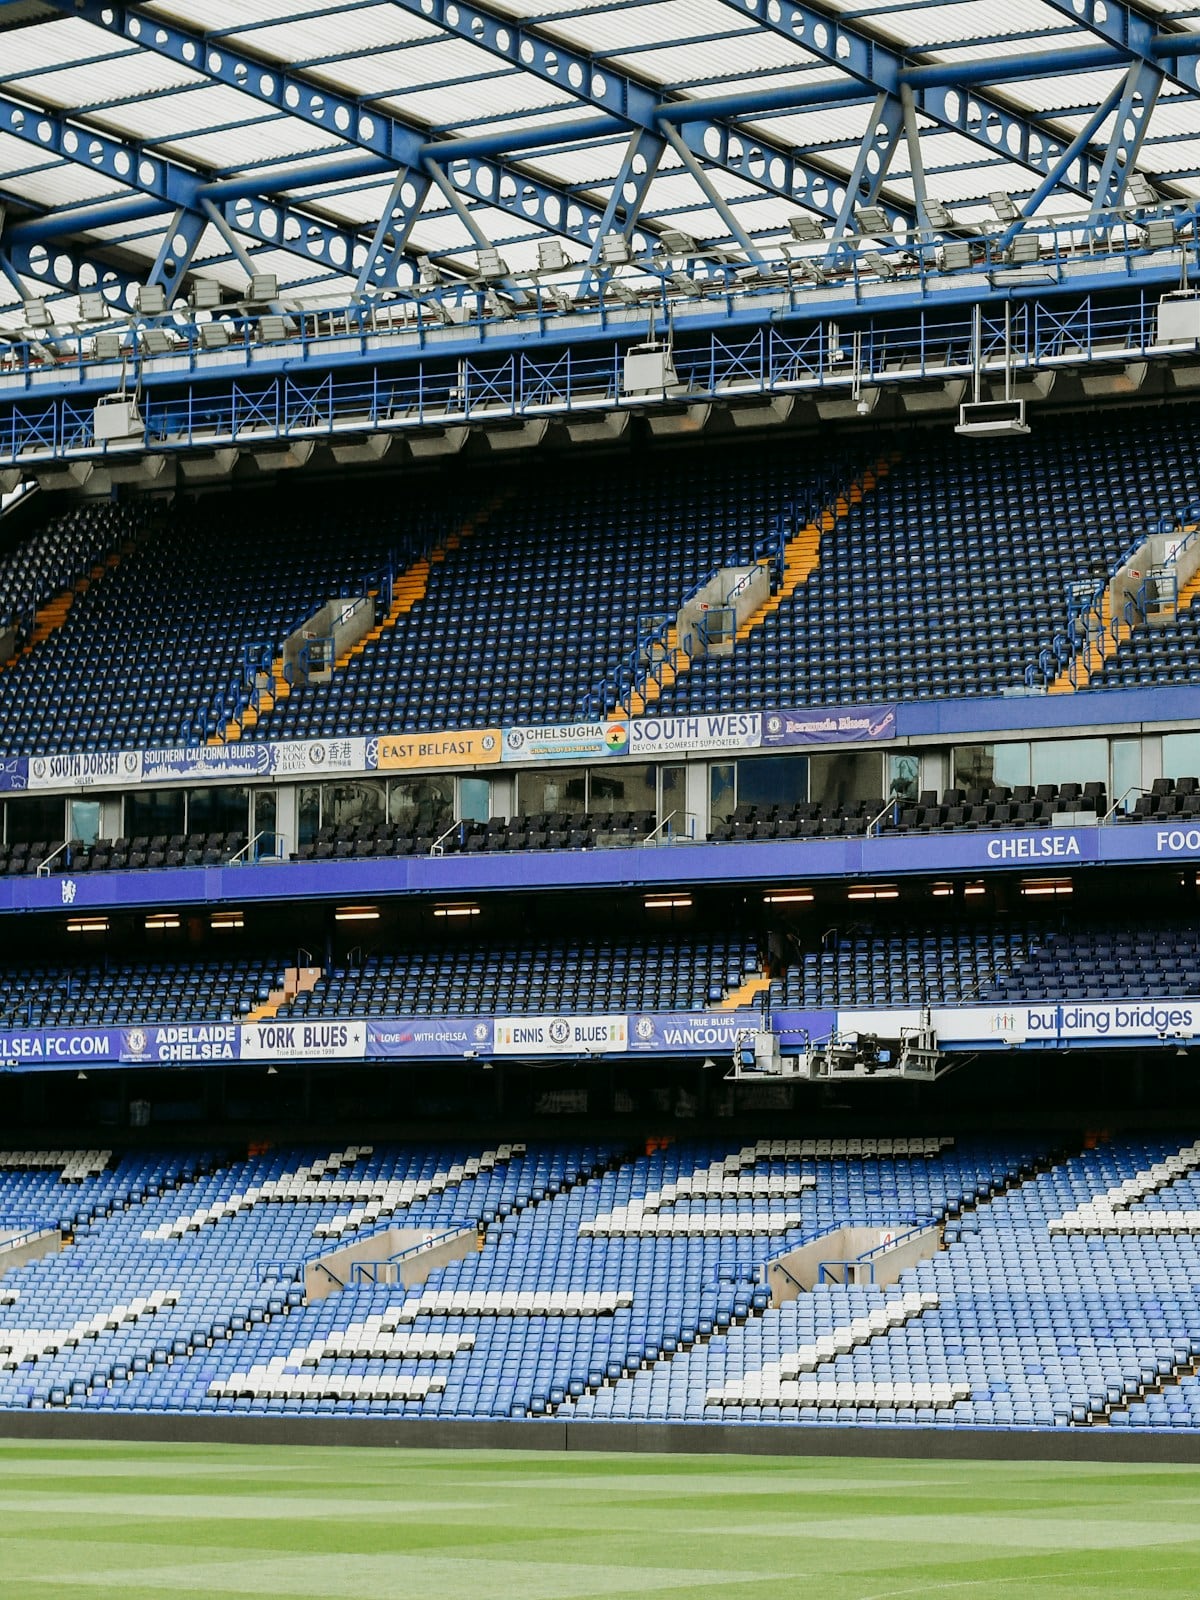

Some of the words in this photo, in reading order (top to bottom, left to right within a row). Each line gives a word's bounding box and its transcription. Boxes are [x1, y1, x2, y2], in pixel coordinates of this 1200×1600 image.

[526, 725, 604, 740] CHELSUGHA
[633, 718, 699, 741] SOUTH
[707, 715, 759, 737] WEST
[282, 743, 306, 753] HONG
[328, 741, 352, 759] 香港
[382, 744, 414, 758] EAST
[418, 741, 474, 756] BELFAST
[632, 743, 656, 751] DEVON
[665, 740, 699, 750] SOMERSET
[700, 738, 740, 748] SUPPORTERS
[144, 749, 185, 764] SOUTHERN
[186, 746, 229, 761] CALIFORNIA
[231, 744, 256, 759] BLUES
[282, 752, 306, 761] KONG
[49, 755, 80, 778] SOUTH
[83, 752, 120, 776] DORSET
[282, 760, 306, 770] BLUES
[987, 836, 1080, 859] CHELSEA
[689, 1018, 709, 1027] TRUE
[711, 1017, 735, 1026] BLUES
[1115, 1007, 1193, 1032] bridges
[155, 1026, 236, 1044] ADELAIDE
[257, 1027, 295, 1049] YORK
[303, 1025, 348, 1048] BLUES
[414, 1032, 435, 1041] WITH
[435, 1031, 468, 1041] CHELSEA
[513, 1028, 543, 1043] ENNIS
[575, 1026, 608, 1041] BLUES
[158, 1043, 234, 1060] CHELSEA
